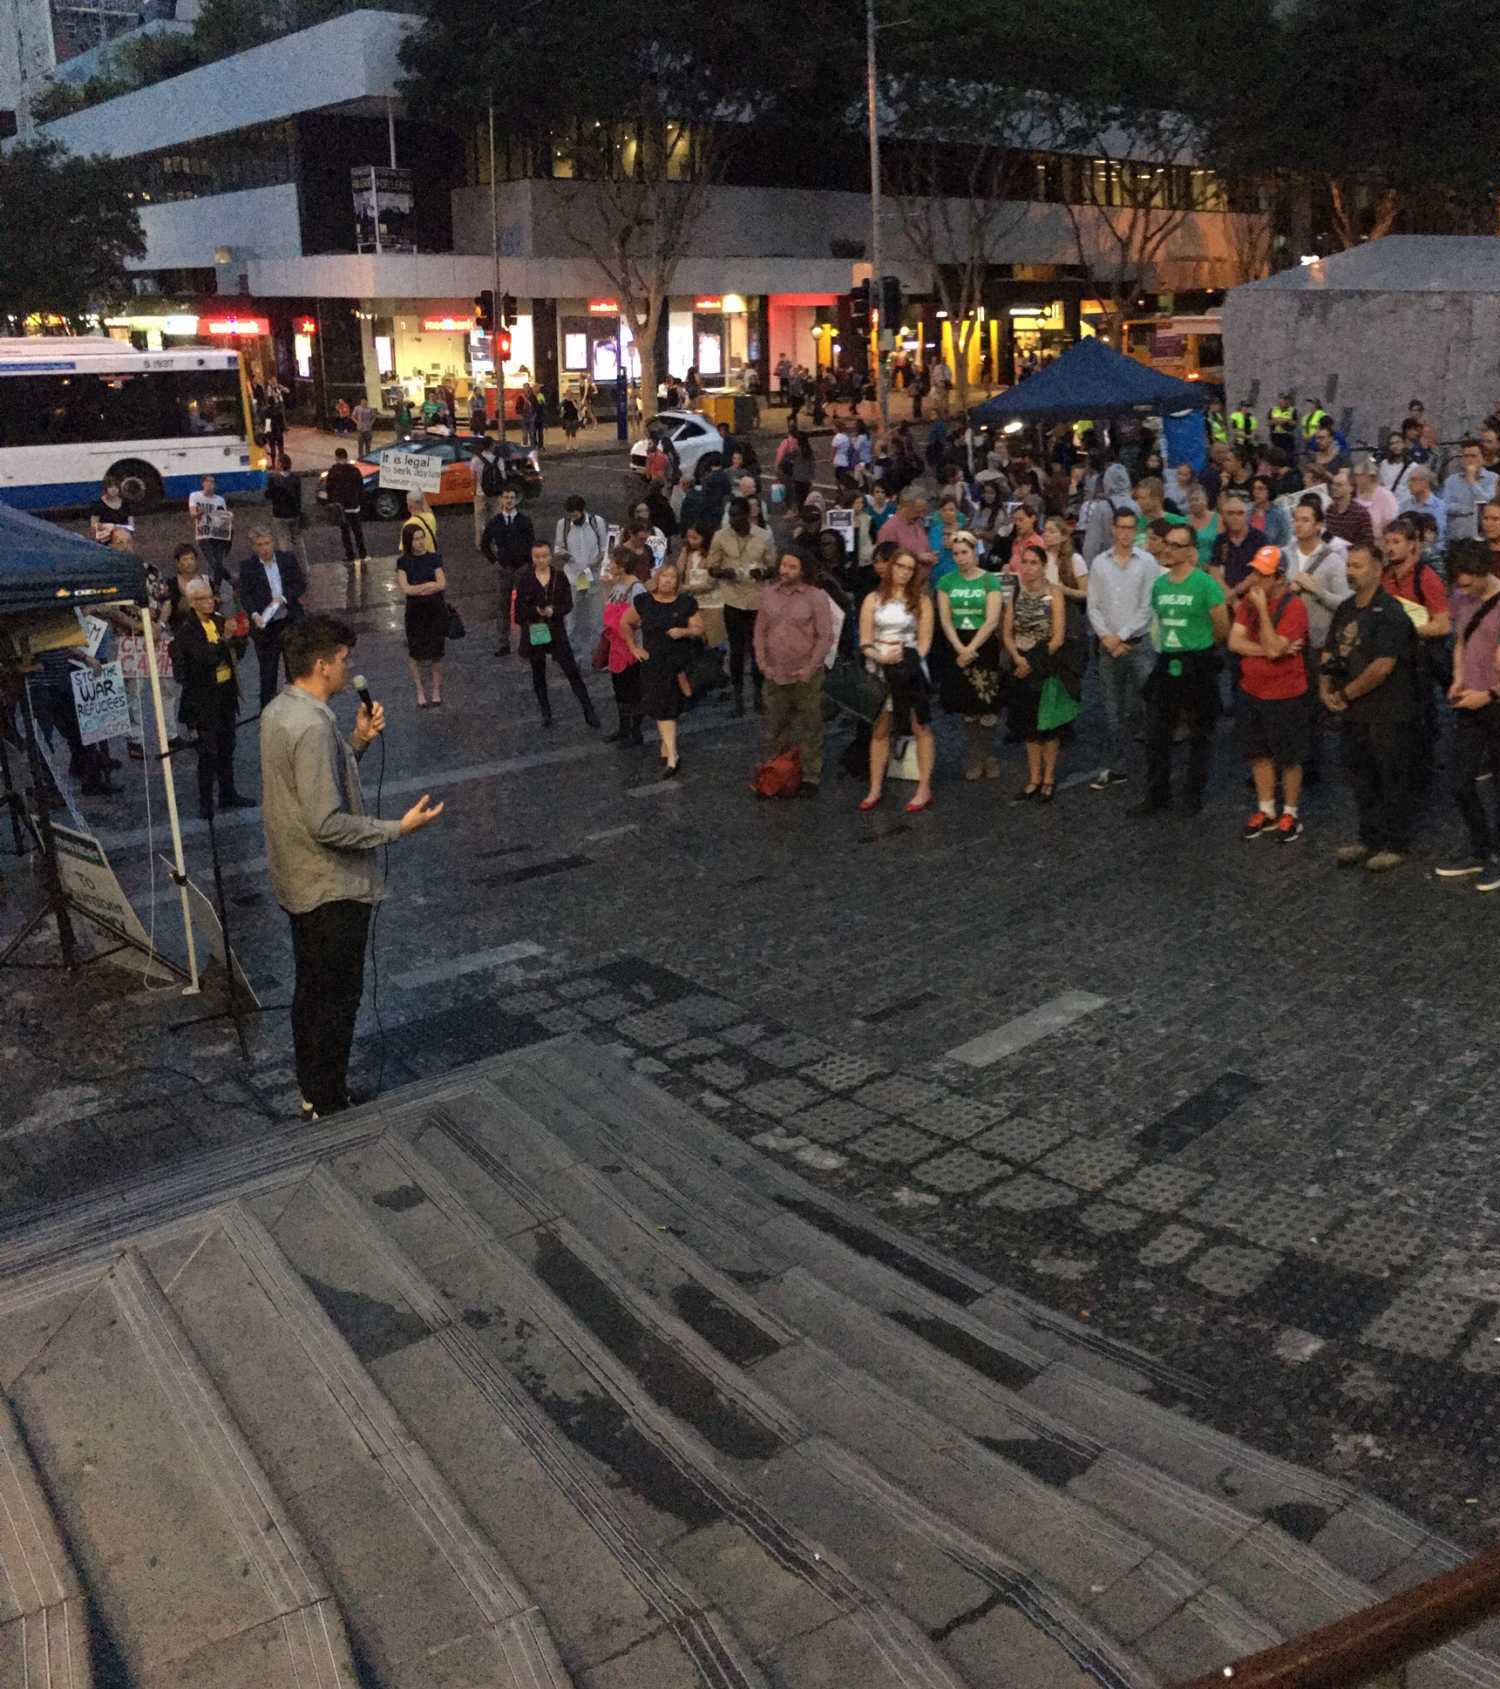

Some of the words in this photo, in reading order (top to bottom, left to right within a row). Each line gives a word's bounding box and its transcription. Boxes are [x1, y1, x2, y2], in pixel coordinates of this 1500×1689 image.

[405, 454, 430, 469] legal
[80, 680, 116, 703] WAR
[77, 695, 126, 718] REFUGEES
